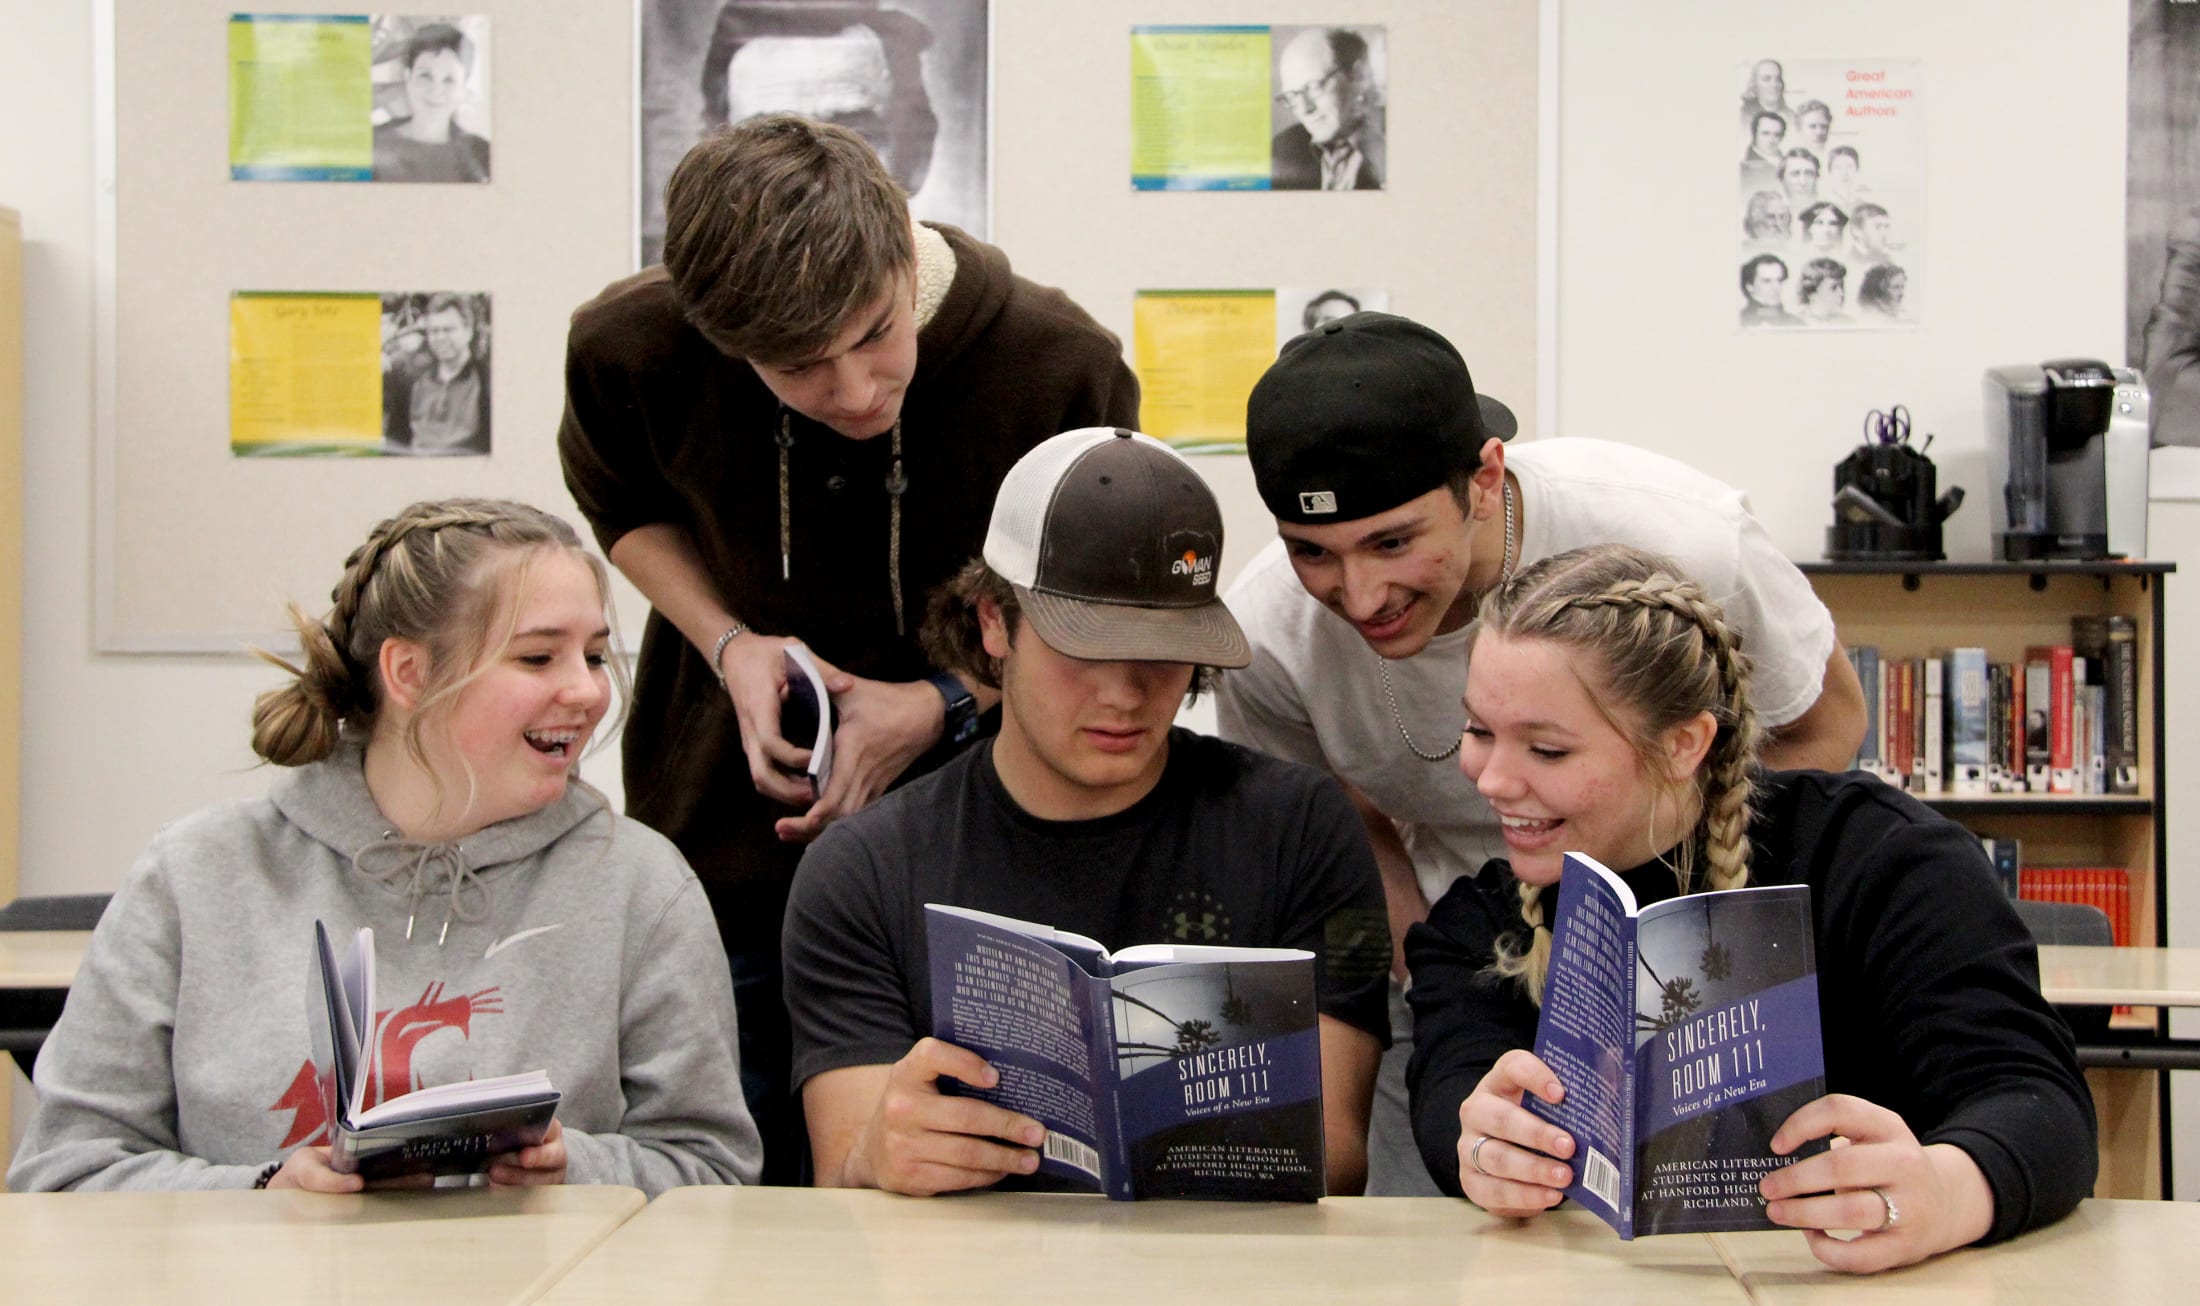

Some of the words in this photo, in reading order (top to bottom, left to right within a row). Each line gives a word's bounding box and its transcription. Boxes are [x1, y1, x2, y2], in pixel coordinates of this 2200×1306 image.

[1846, 70, 1886, 82] Great
[1845, 88, 1912, 99] American
[1845, 105, 1896, 117] Authors
[1667, 999, 1766, 1062] SINCERELY,
[1672, 1053, 1721, 1100] ROOM
[1732, 1040, 1763, 1077] 111
[1184, 1076, 1230, 1105] ROOM
[1241, 1070, 1267, 1095] 111
[1672, 1101, 1701, 1117] Voices
[1703, 1092, 1714, 1109] of
[1715, 1095, 1721, 1103] a
[1723, 1086, 1747, 1100] New
[1749, 1078, 1766, 1091] Era
[1185, 1106, 1211, 1117] Voices
[1213, 1102, 1222, 1112] of
[1232, 1099, 1252, 1108] New
[1255, 1096, 1270, 1104] Era
[1168, 1145, 1225, 1153] AMERICAN
[1230, 1146, 1296, 1156] LITERATURE
[1246, 1155, 1279, 1163] ROOM
[1172, 1161, 1226, 1169] HANFORD
[1230, 1163, 1259, 1171] HIGH
[1654, 1159, 1718, 1174] AMERICAN
[1194, 1169, 1255, 1179] RICHLAND,
[1652, 1172, 1716, 1186] STUDENTS
[1721, 1172, 1736, 1181] OF
[1742, 1170, 1769, 1180] ROO
[1641, 1190, 1655, 1200] AT
[1659, 1186, 1720, 1198] HANFORD
[1724, 1185, 1757, 1195] HIGH
[1683, 1198, 1753, 1209] RICHLAND,
[1757, 1197, 1767, 1206] W
